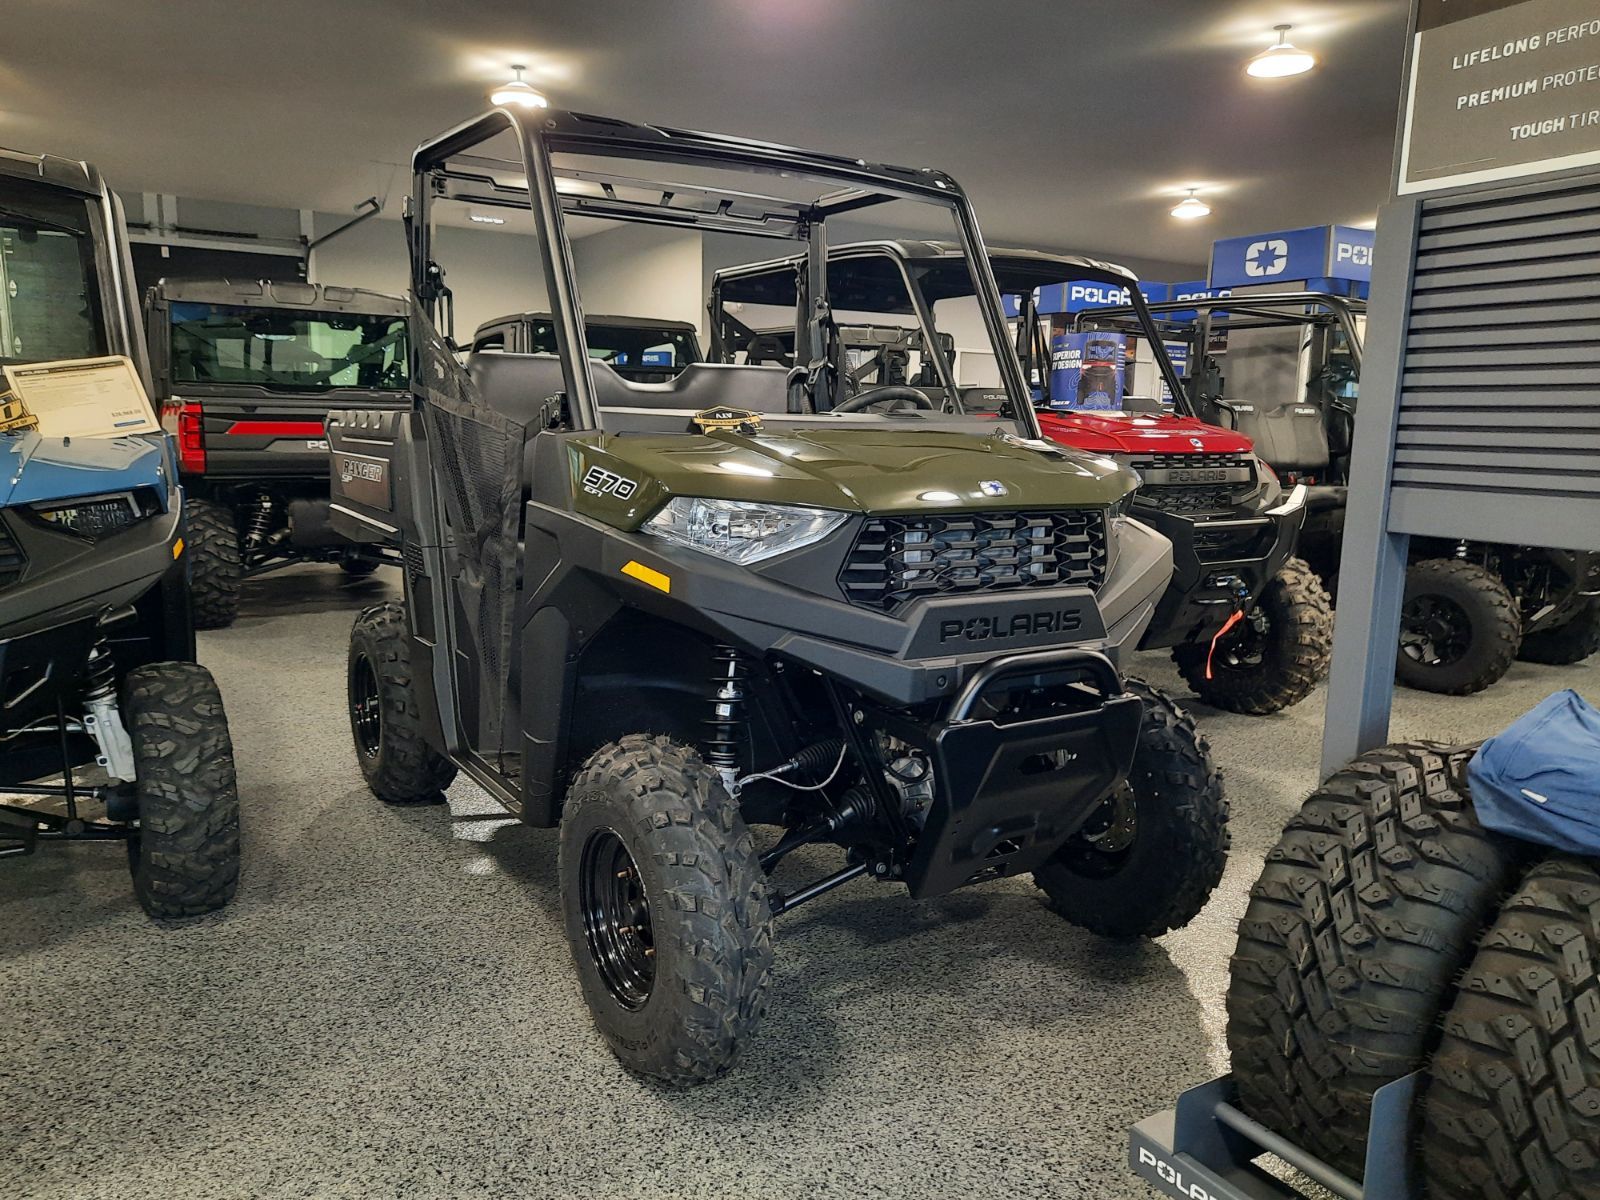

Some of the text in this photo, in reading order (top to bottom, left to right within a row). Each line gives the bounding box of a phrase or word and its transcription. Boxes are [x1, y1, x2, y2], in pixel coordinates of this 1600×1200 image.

[1452, 35, 1541, 70] LIFELONG
[1456, 65, 1600, 110] PREMIUM PROTE
[1510, 117, 1565, 140] TOUGH
[1058, 360, 1082, 370] DESIGN
[343, 459, 382, 482] RANGER
[582, 465, 637, 500] 570
[1169, 470, 1227, 481] POLARIS
[583, 485, 603, 498] EFI
[939, 608, 1082, 644] POLARIS
[1139, 1146, 1218, 1200] POLA
